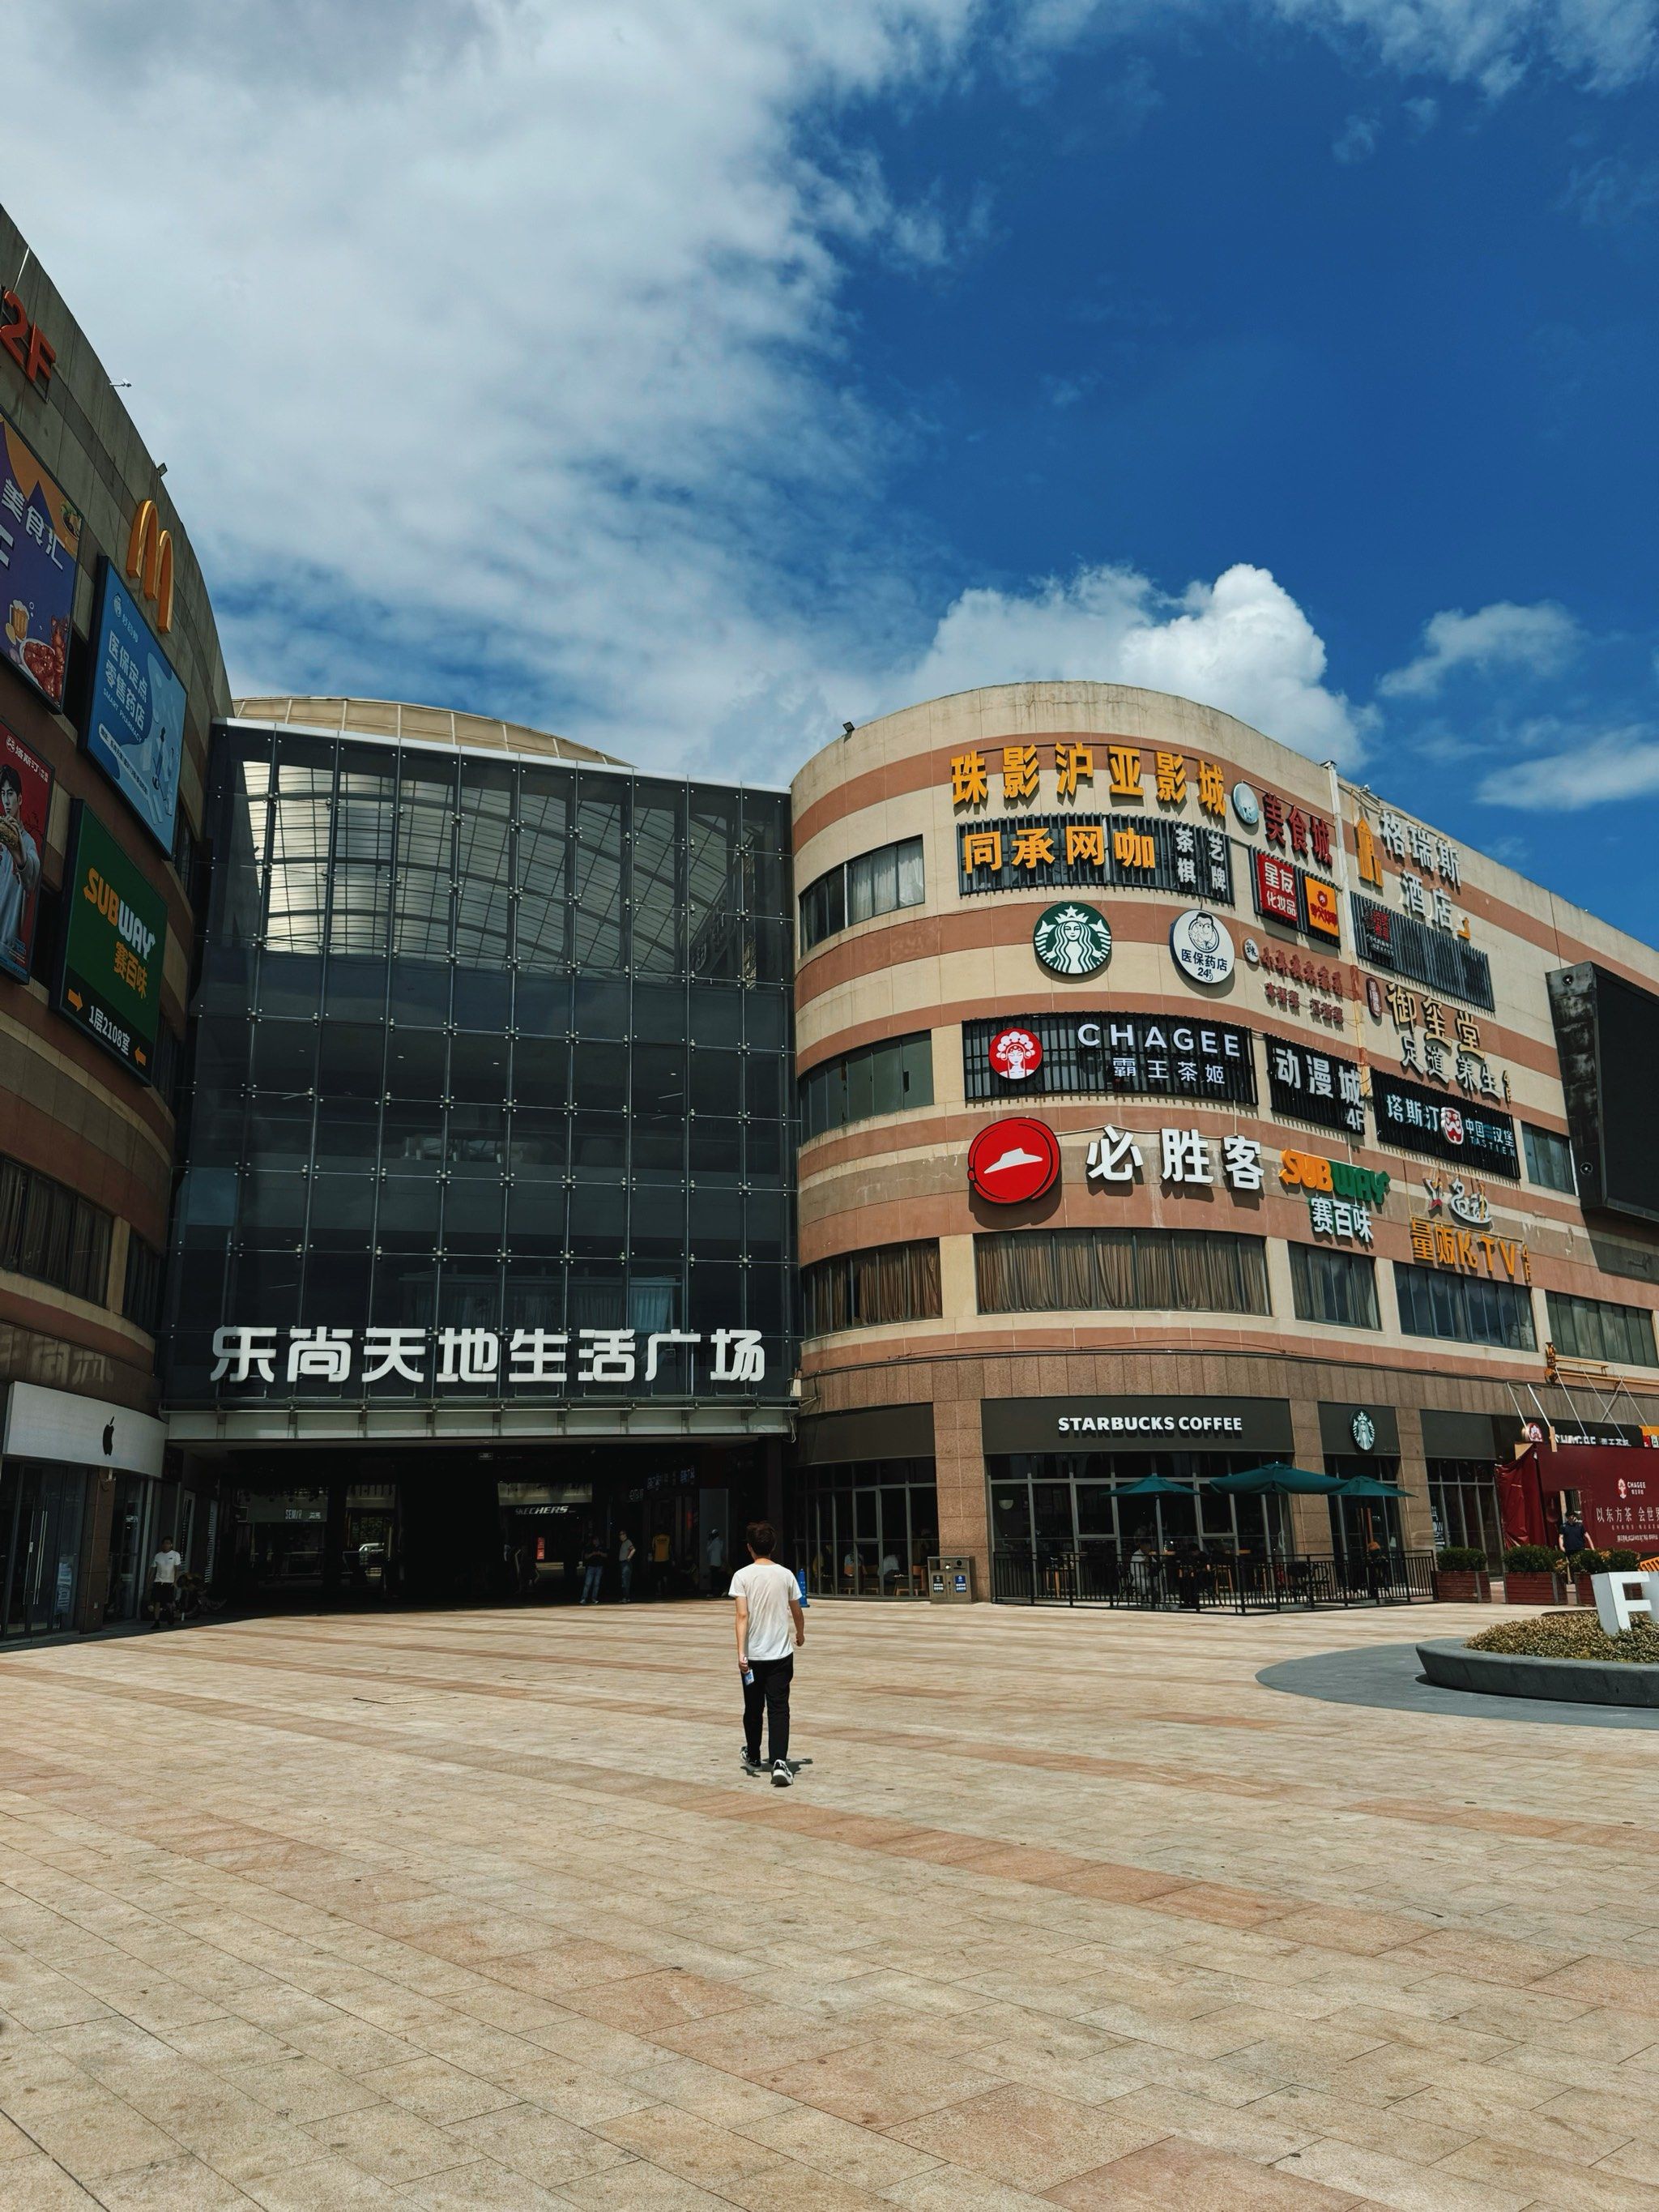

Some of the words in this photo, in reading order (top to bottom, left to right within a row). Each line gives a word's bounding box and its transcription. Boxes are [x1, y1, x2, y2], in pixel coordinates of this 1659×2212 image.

[0, 290, 56, 383] 2F
[2, 478, 65, 571] 美食汇
[108, 630, 148, 703] 医保定点
[104, 659, 145, 732] 零售药店
[951, 741, 1226, 817] 珠影沪亚影城
[964, 826, 1156, 874] 同承网咖
[1262, 792, 1333, 869] 美食城
[1380, 810, 1461, 888] 格瑞斯
[83, 868, 156, 960] SUBWAY
[1266, 890, 1297, 917] 化妆品
[1401, 870, 1457, 933] 酒店
[114, 942, 147, 999] 赛百味
[1181, 949, 1228, 971] 医保药店
[88, 1006, 130, 1056] 1层2108室
[1077, 1023, 1240, 1057] CHAGEE
[1112, 1057, 1226, 1085] 霸王茶姬
[1273, 1048, 1364, 1108] 动漫城
[1401, 1036, 1502, 1098] 足道养生
[1346, 1108, 1364, 1131] 4F
[1386, 1094, 1439, 1133] 塔斯汀
[1086, 1125, 1265, 1190] 必胜客
[1279, 1149, 1391, 1206] SUBWAY
[1310, 1197, 1374, 1243] 赛百味
[210, 1326, 766, 1383] 乐尚天地生活广场
[1058, 1416, 1175, 1431] STARBUCKS
[1178, 1416, 1243, 1432] COFFEE
[514, 1505, 570, 1515] SKECHERS
[1627, 1481, 1646, 1489] CHAGEE
[1596, 1506, 1632, 1523] 以东方茶
